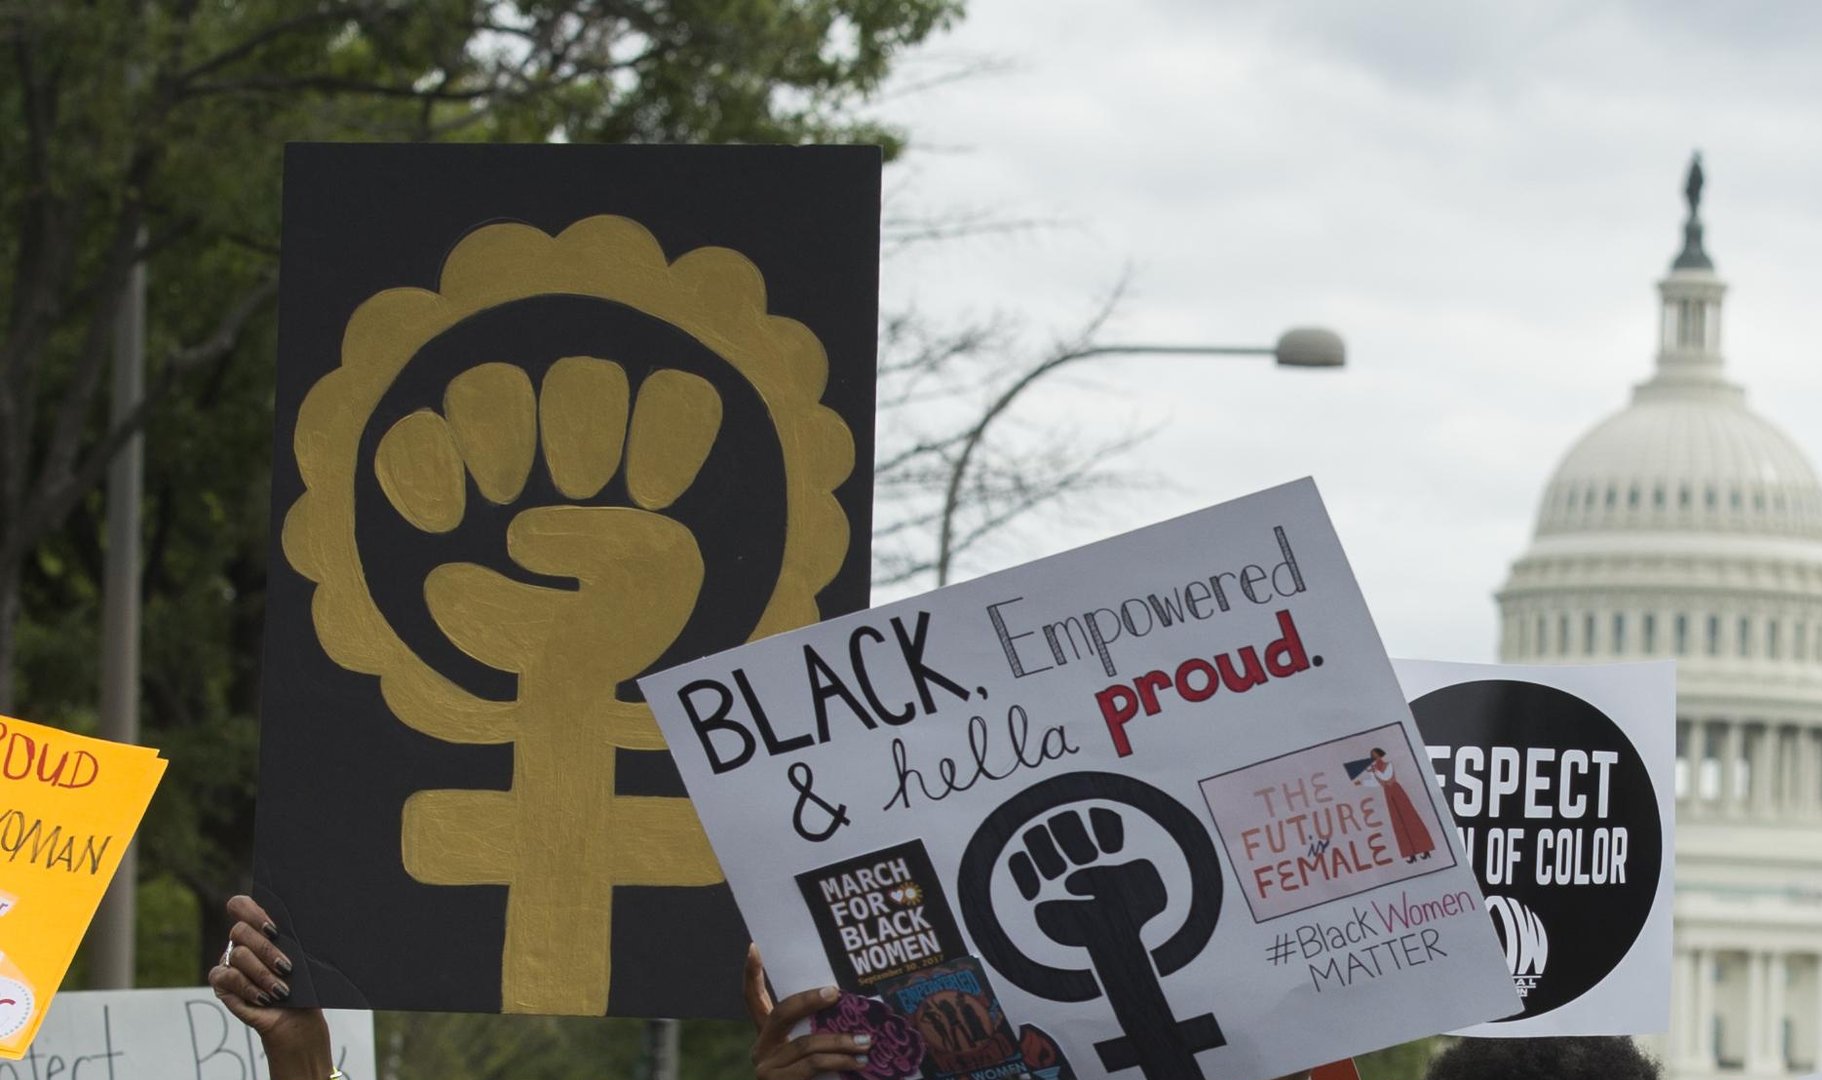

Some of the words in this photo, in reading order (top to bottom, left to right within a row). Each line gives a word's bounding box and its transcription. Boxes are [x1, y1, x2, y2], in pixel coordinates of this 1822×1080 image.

[677, 611, 988, 775] BLACK,
[987, 526, 1307, 679] Empowered
[883, 705, 1080, 811] hella
[1095, 610, 1325, 758] proud.
[1254, 772, 1333, 818] THE
[1241, 798, 1383, 861] FUTURE
[1308, 835, 1330, 858] is
[819, 858, 911, 902] MARCH
[1254, 833, 1393, 899] FEMALE
[1486, 827, 1524, 885] OF
[1535, 827, 1628, 885] COLOR
[830, 888, 890, 927] FOR
[840, 906, 932, 951] BLACK
[848, 931, 941, 977] WOMEN
[1308, 928, 1447, 992] MATTER
